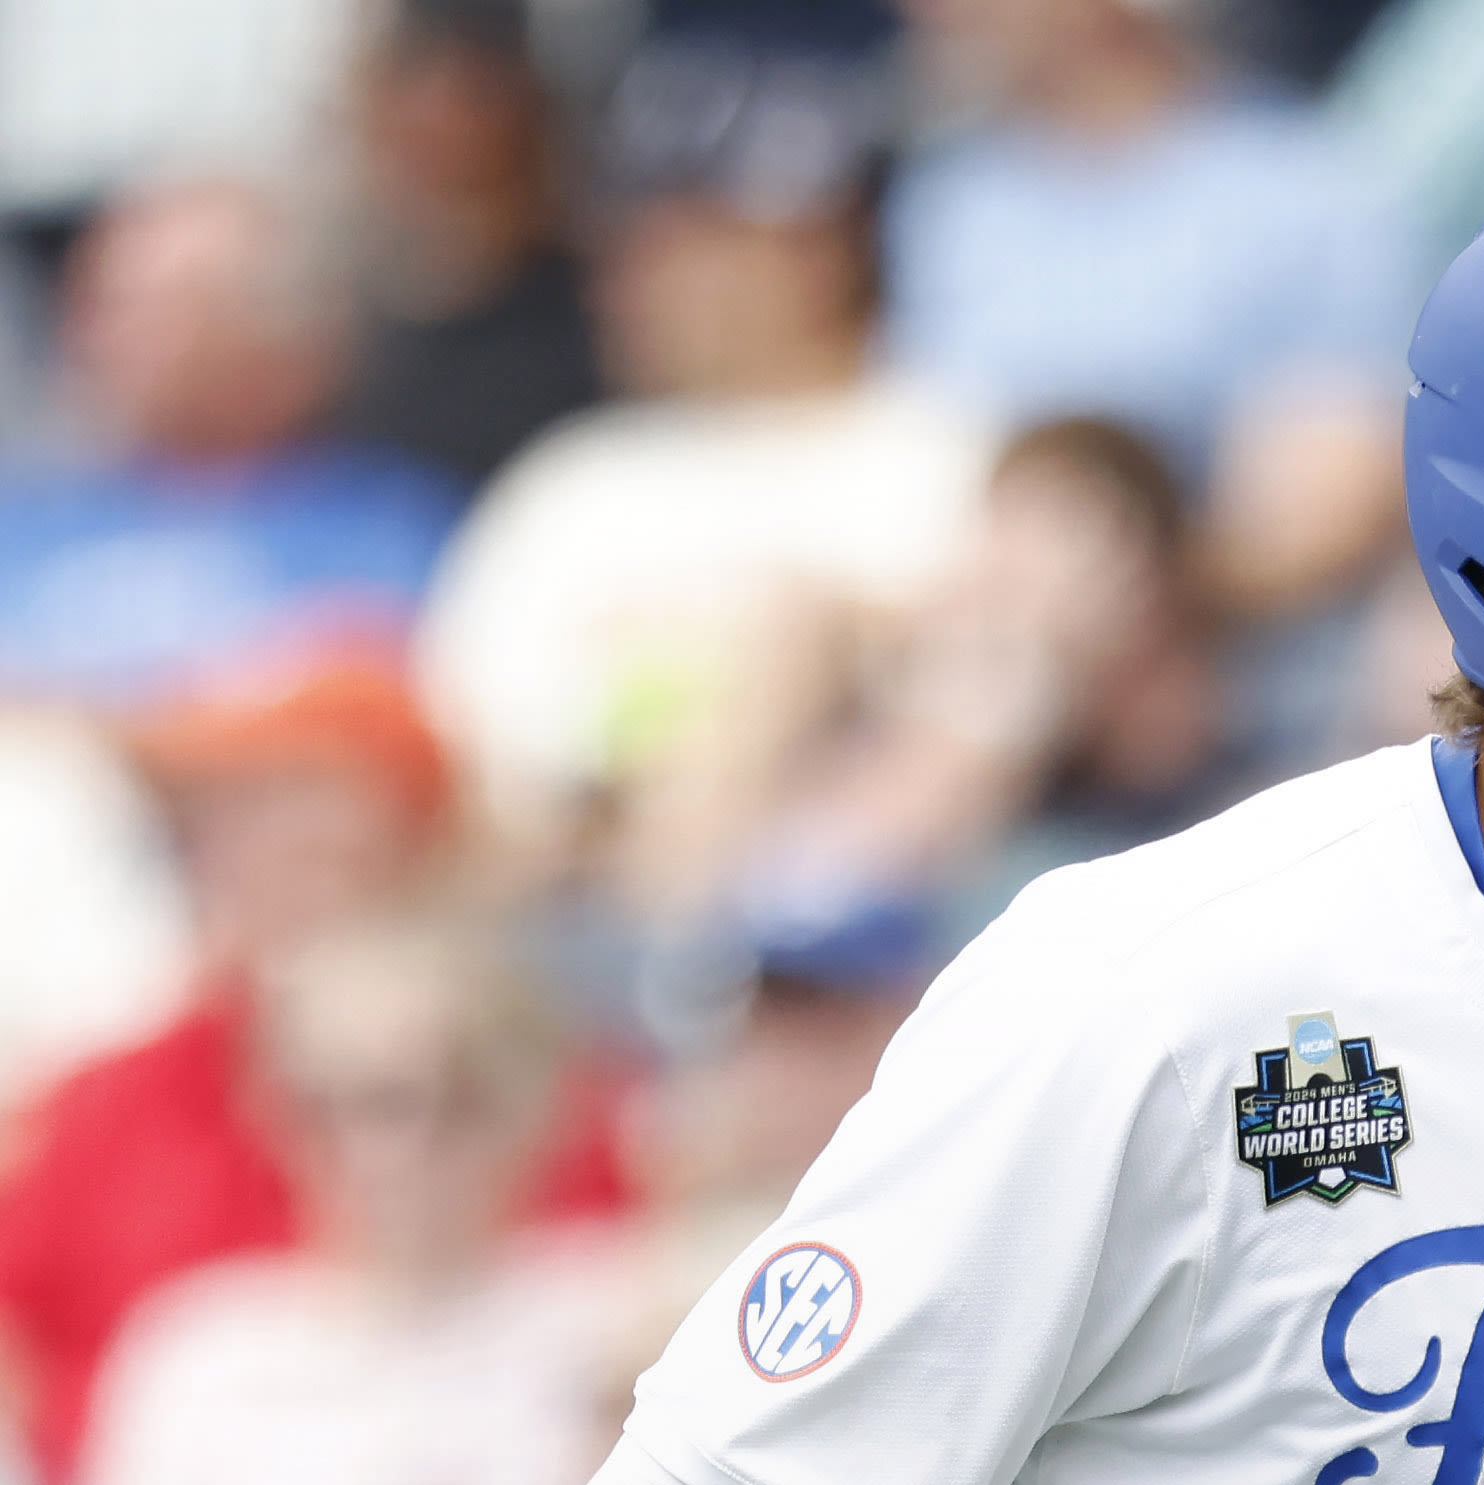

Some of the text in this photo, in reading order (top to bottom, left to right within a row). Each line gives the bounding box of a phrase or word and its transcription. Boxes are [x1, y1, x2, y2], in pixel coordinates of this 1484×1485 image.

[1299, 1038, 1335, 1054] NCAA
[1284, 1083, 1356, 1103] 2024 MEN'S
[1276, 1094, 1369, 1130] COLLEGE
[1243, 1115, 1404, 1160] WORLD SERIES
[1303, 1151, 1357, 1168] OMAHA
[745, 1249, 854, 1375] SEC
